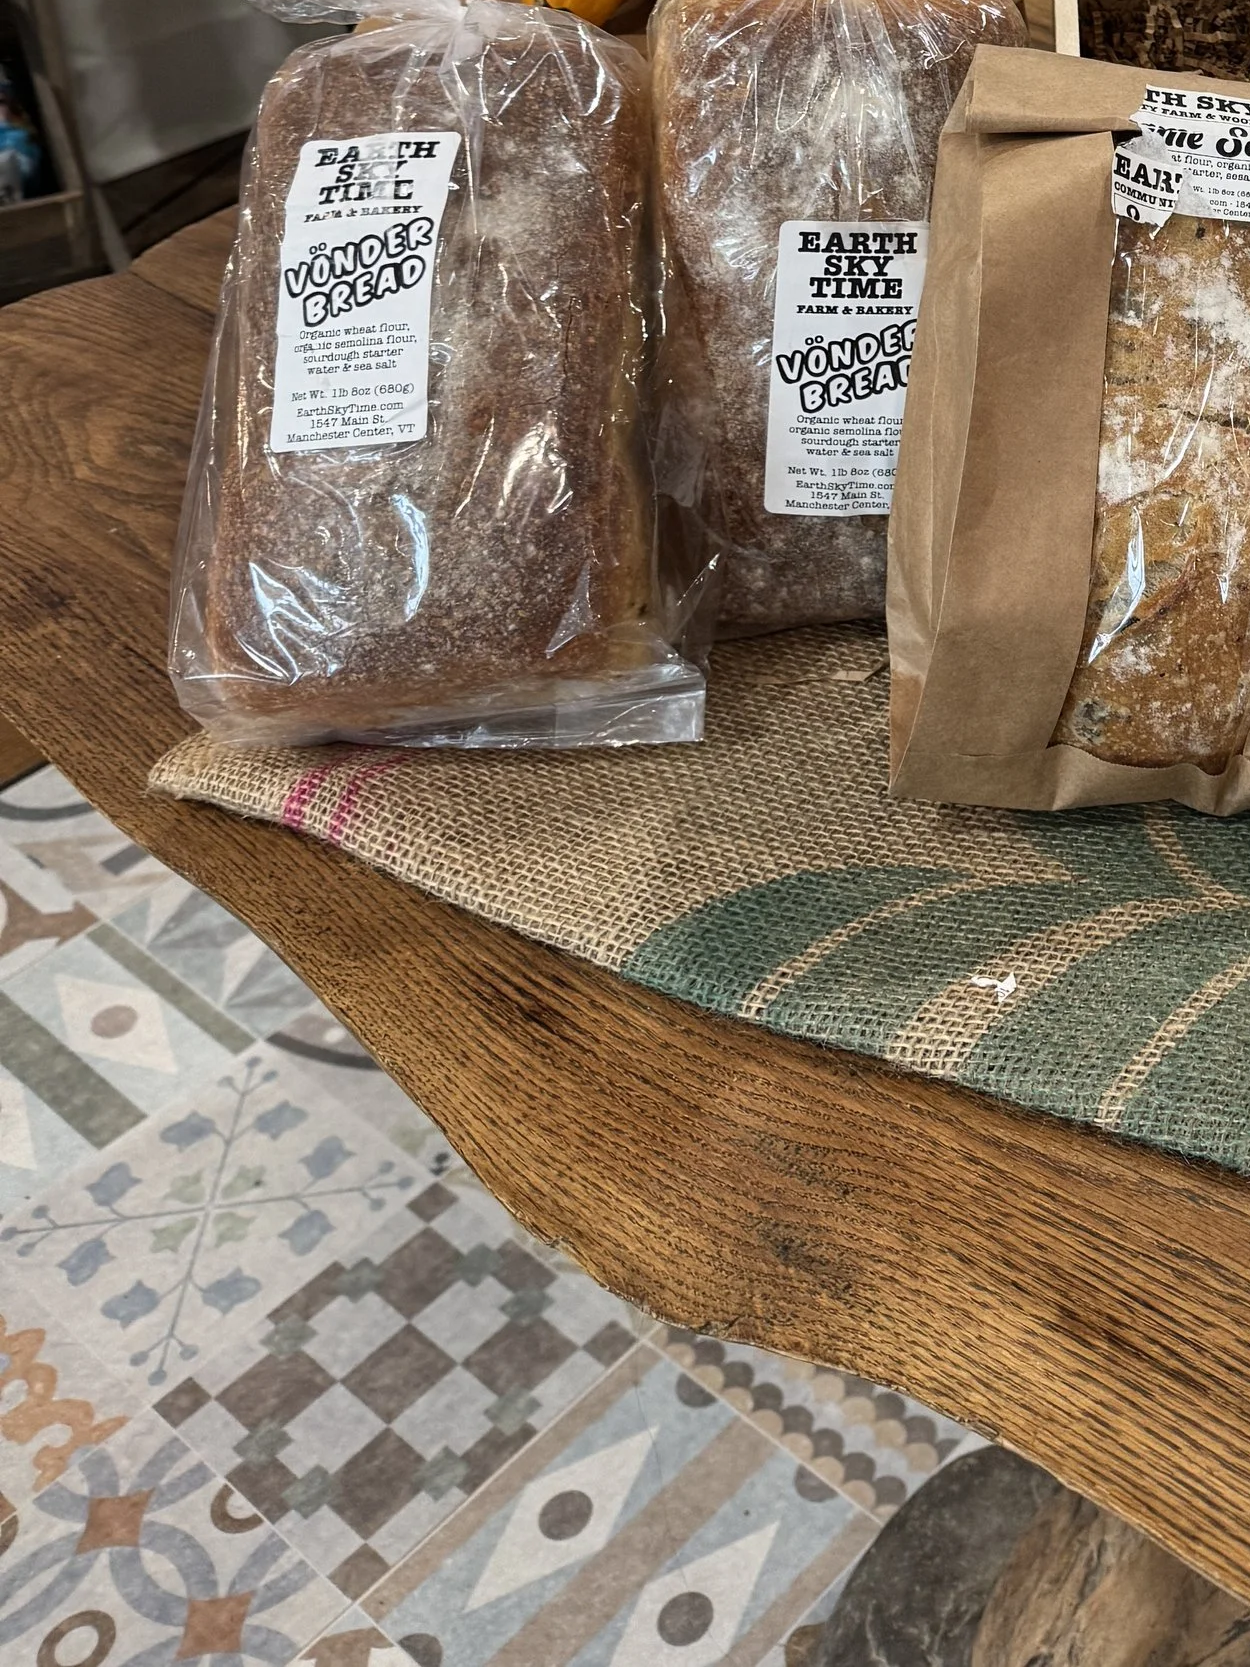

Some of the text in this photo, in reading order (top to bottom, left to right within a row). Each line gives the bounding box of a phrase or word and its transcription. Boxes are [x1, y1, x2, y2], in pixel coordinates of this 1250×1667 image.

[1161, 107, 1202, 119] FARM
[1205, 113, 1216, 121] &
[315, 141, 440, 167] EARTH
[1184, 154, 1213, 169] flour,
[335, 160, 408, 184] SKY
[318, 179, 414, 206] TIME
[360, 205, 423, 217] BAKERY
[798, 231, 918, 254] EARTH
[284, 216, 435, 299] VÖNDER
[823, 254, 894, 277] SKY
[302, 254, 427, 328] BREAD
[809, 277, 903, 299] TIME
[796, 305, 914, 315] FARM & BAKERY
[299, 322, 410, 341] Organic wheat flour,
[334, 336, 383, 350] semolina
[386, 333, 418, 345] flour,
[303, 347, 404, 365] sourdough starter
[307, 359, 397, 375] water & sea salt
[291, 390, 307, 402] Net
[309, 388, 328, 400] Wt.
[351, 386, 371, 396] 8oz
[374, 382, 415, 397] (680g)
[296, 401, 404, 418] EarthSkyTime.com
[310, 417, 339, 429] 1547
[341, 415, 369, 426] Main
[796, 415, 840, 426] Organic
[843, 415, 876, 425] wheat
[286, 423, 416, 444] Manchester Center, VT
[788, 426, 831, 436] organic
[832, 426, 882, 436] semolina
[800, 437, 901, 447] sourdough starter
[806, 448, 895, 457] water & sea salt
[787, 466, 807, 476] Net
[809, 467, 827, 477] Wt.
[850, 468, 870, 477] 8oz
[811, 490, 885, 501] 1547 Main St.
[785, 499, 890, 511] Manchester Center,
